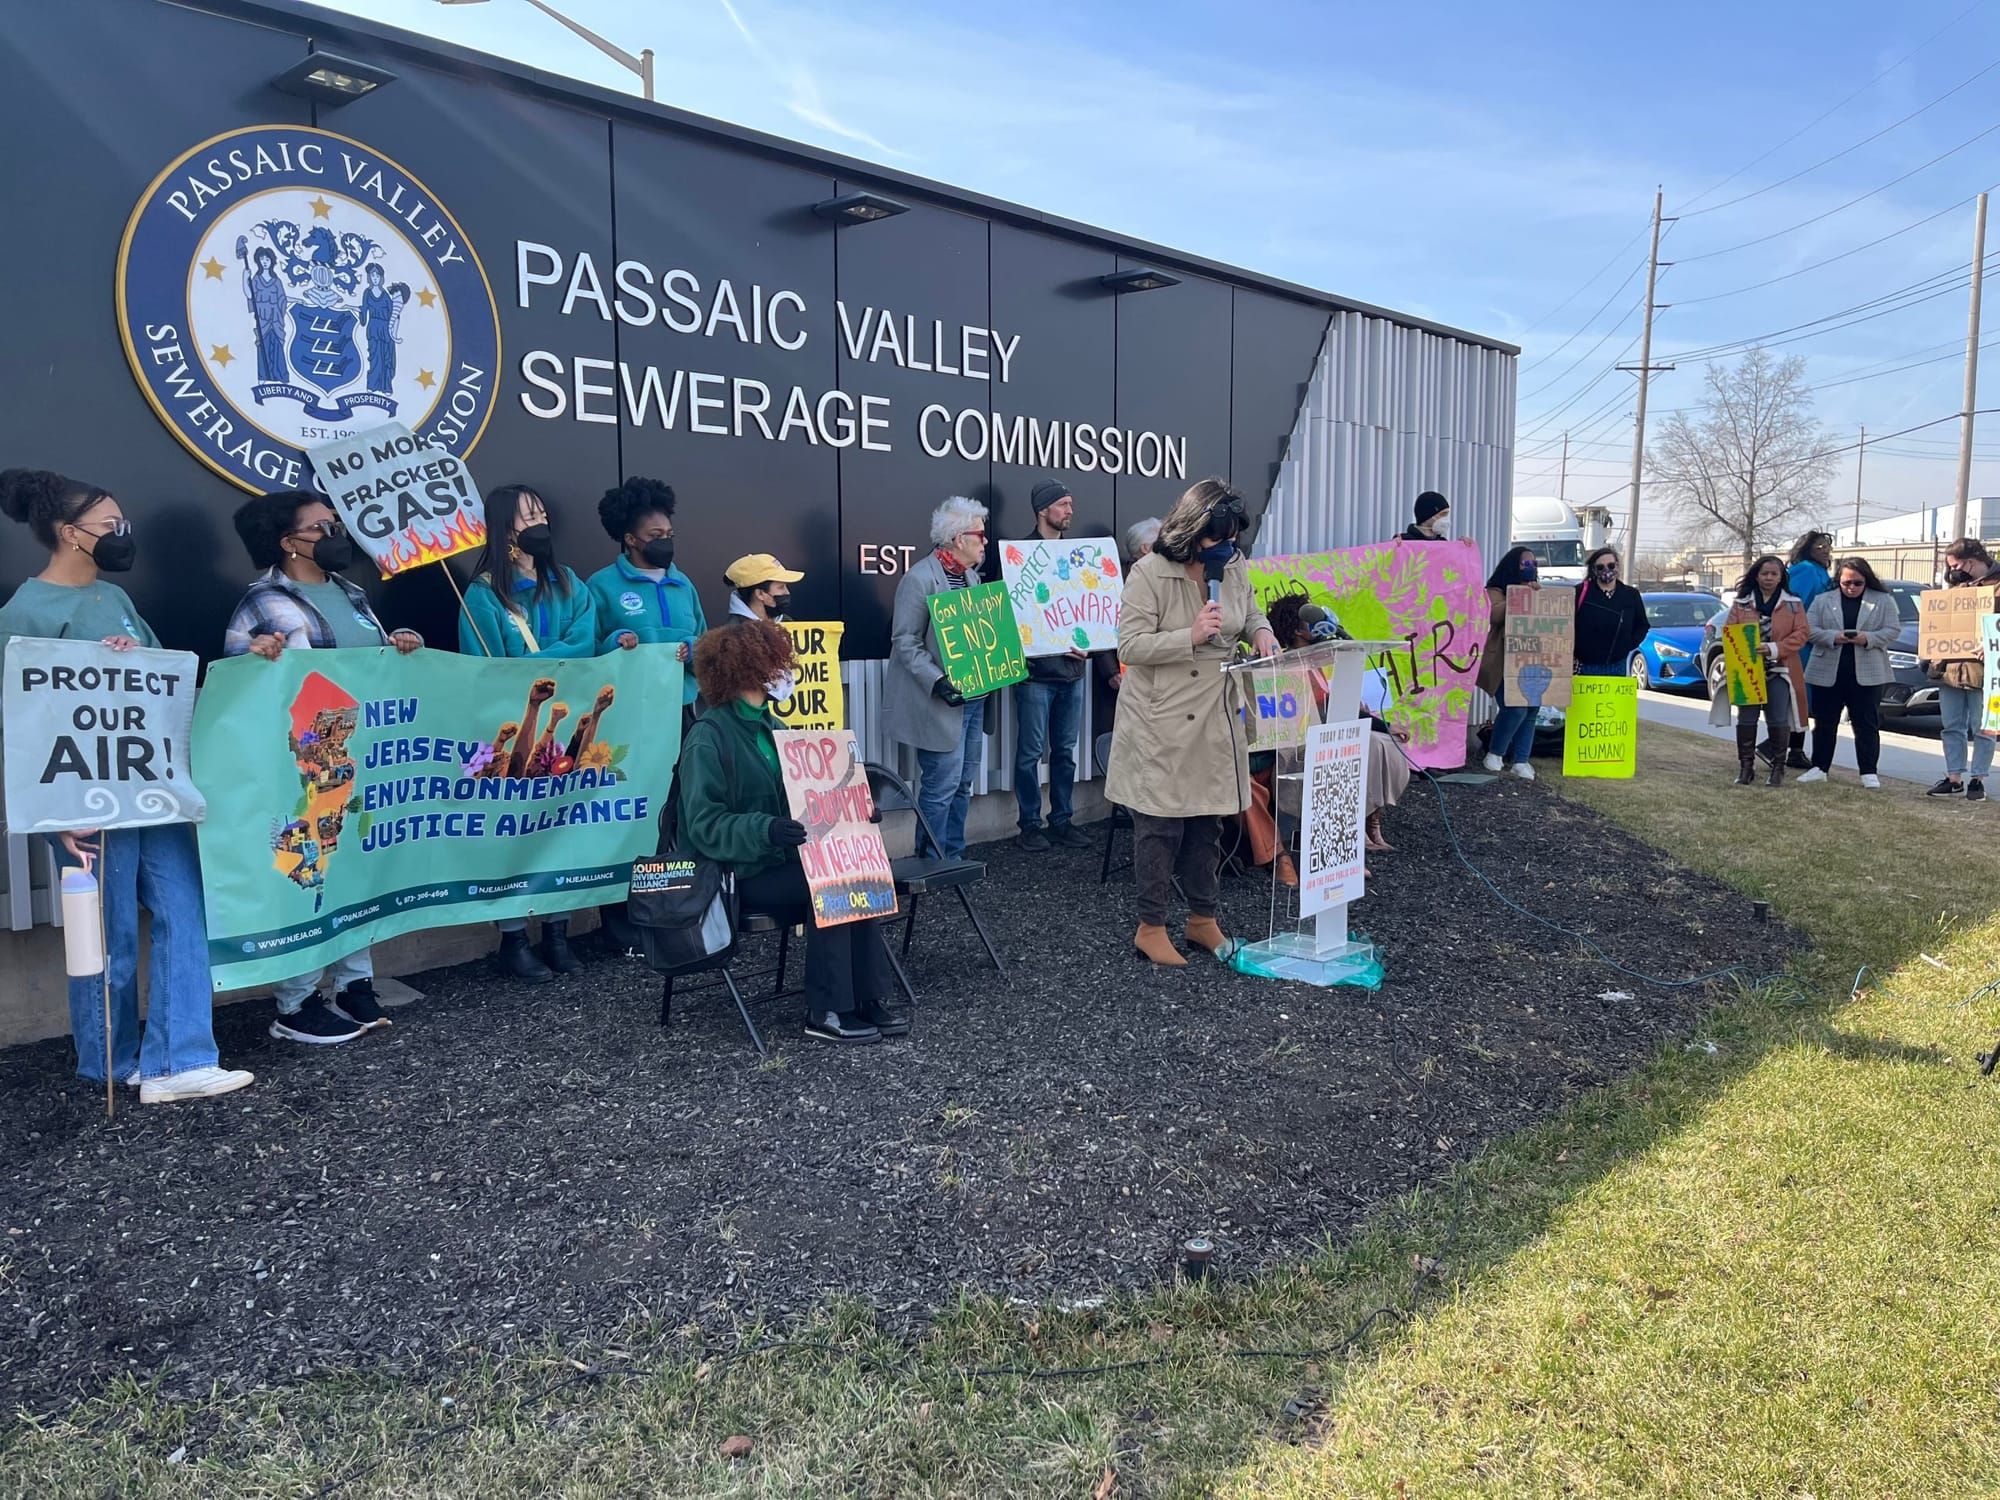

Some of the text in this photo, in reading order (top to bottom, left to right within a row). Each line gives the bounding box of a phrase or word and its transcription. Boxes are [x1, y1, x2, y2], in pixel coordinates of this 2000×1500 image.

[166, 143, 465, 267] PASSAIC VALLEY
[516, 240, 1021, 383] PASSAIC VALLEY
[146, 324, 302, 488] SEWERAGE
[259, 386, 392, 409] LIBERTY AND PROSPERITY
[520, 350, 1187, 480] SEWERAGE COMMISSION
[300, 426, 330, 439] EST.
[326, 452, 364, 479] NO
[341, 458, 459, 511] FRACKED
[357, 475, 474, 539] GAS!
[1009, 541, 1051, 611] PROTECT
[933, 585, 1003, 624] Gov Murphy
[1928, 596, 1993, 612] NO PERMITS
[793, 628, 826, 655] UR
[941, 617, 997, 660] END
[1926, 638, 1983, 655] POISO
[23, 666, 180, 696] PROTECT
[365, 698, 418, 728] NEW
[773, 689, 828, 717] OUR
[1257, 693, 1297, 719] NO
[1596, 702, 1616, 718] ES
[73, 705, 146, 731] OUR
[1579, 720, 1628, 739] DERECHO
[39, 736, 174, 784] AIR!
[364, 737, 480, 769] JERSEY
[783, 738, 837, 781] STOP
[1578, 743, 1626, 760] HUMANO
[363, 766, 616, 812] ENVIRONMENTAL
[804, 783, 876, 825] DUMPING
[361, 796, 649, 853] JUSTICE ALLIANCE
[633, 861, 696, 874] SOUTH WARD
[802, 834, 889, 879] ON NEWARK
[479, 881, 529, 894] NJEJALLIANCE
[566, 872, 614, 885] NJEJALLIANCE
[632, 869, 695, 882] ENVIRONMENTAL
[632, 879, 669, 889] ALLIANCE
[257, 927, 322, 949] WWW.NJEJA.ORG
